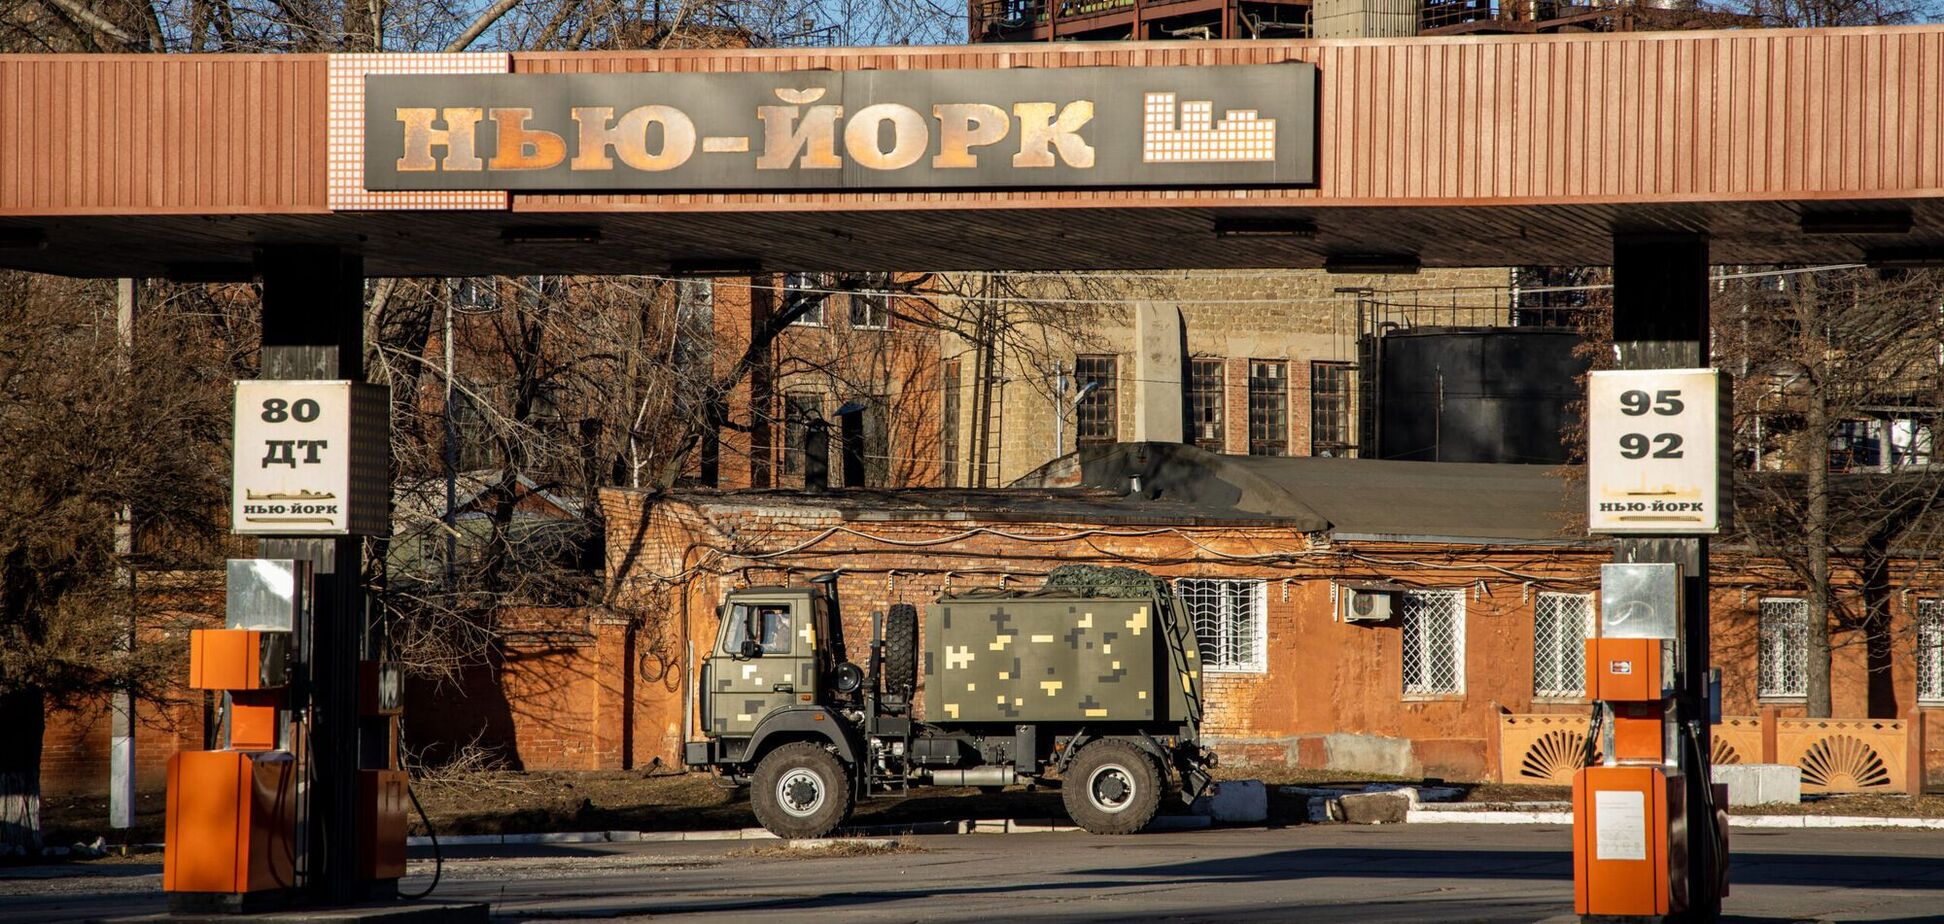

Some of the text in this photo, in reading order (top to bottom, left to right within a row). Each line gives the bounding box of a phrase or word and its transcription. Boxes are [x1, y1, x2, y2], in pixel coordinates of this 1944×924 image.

[396, 87, 1096, 171] НЬЮ-ЙОРК
[260, 398, 321, 423] 80
[1619, 389, 1685, 417] 95
[261, 439, 328, 469] ДТ
[1618, 432, 1684, 460] 92
